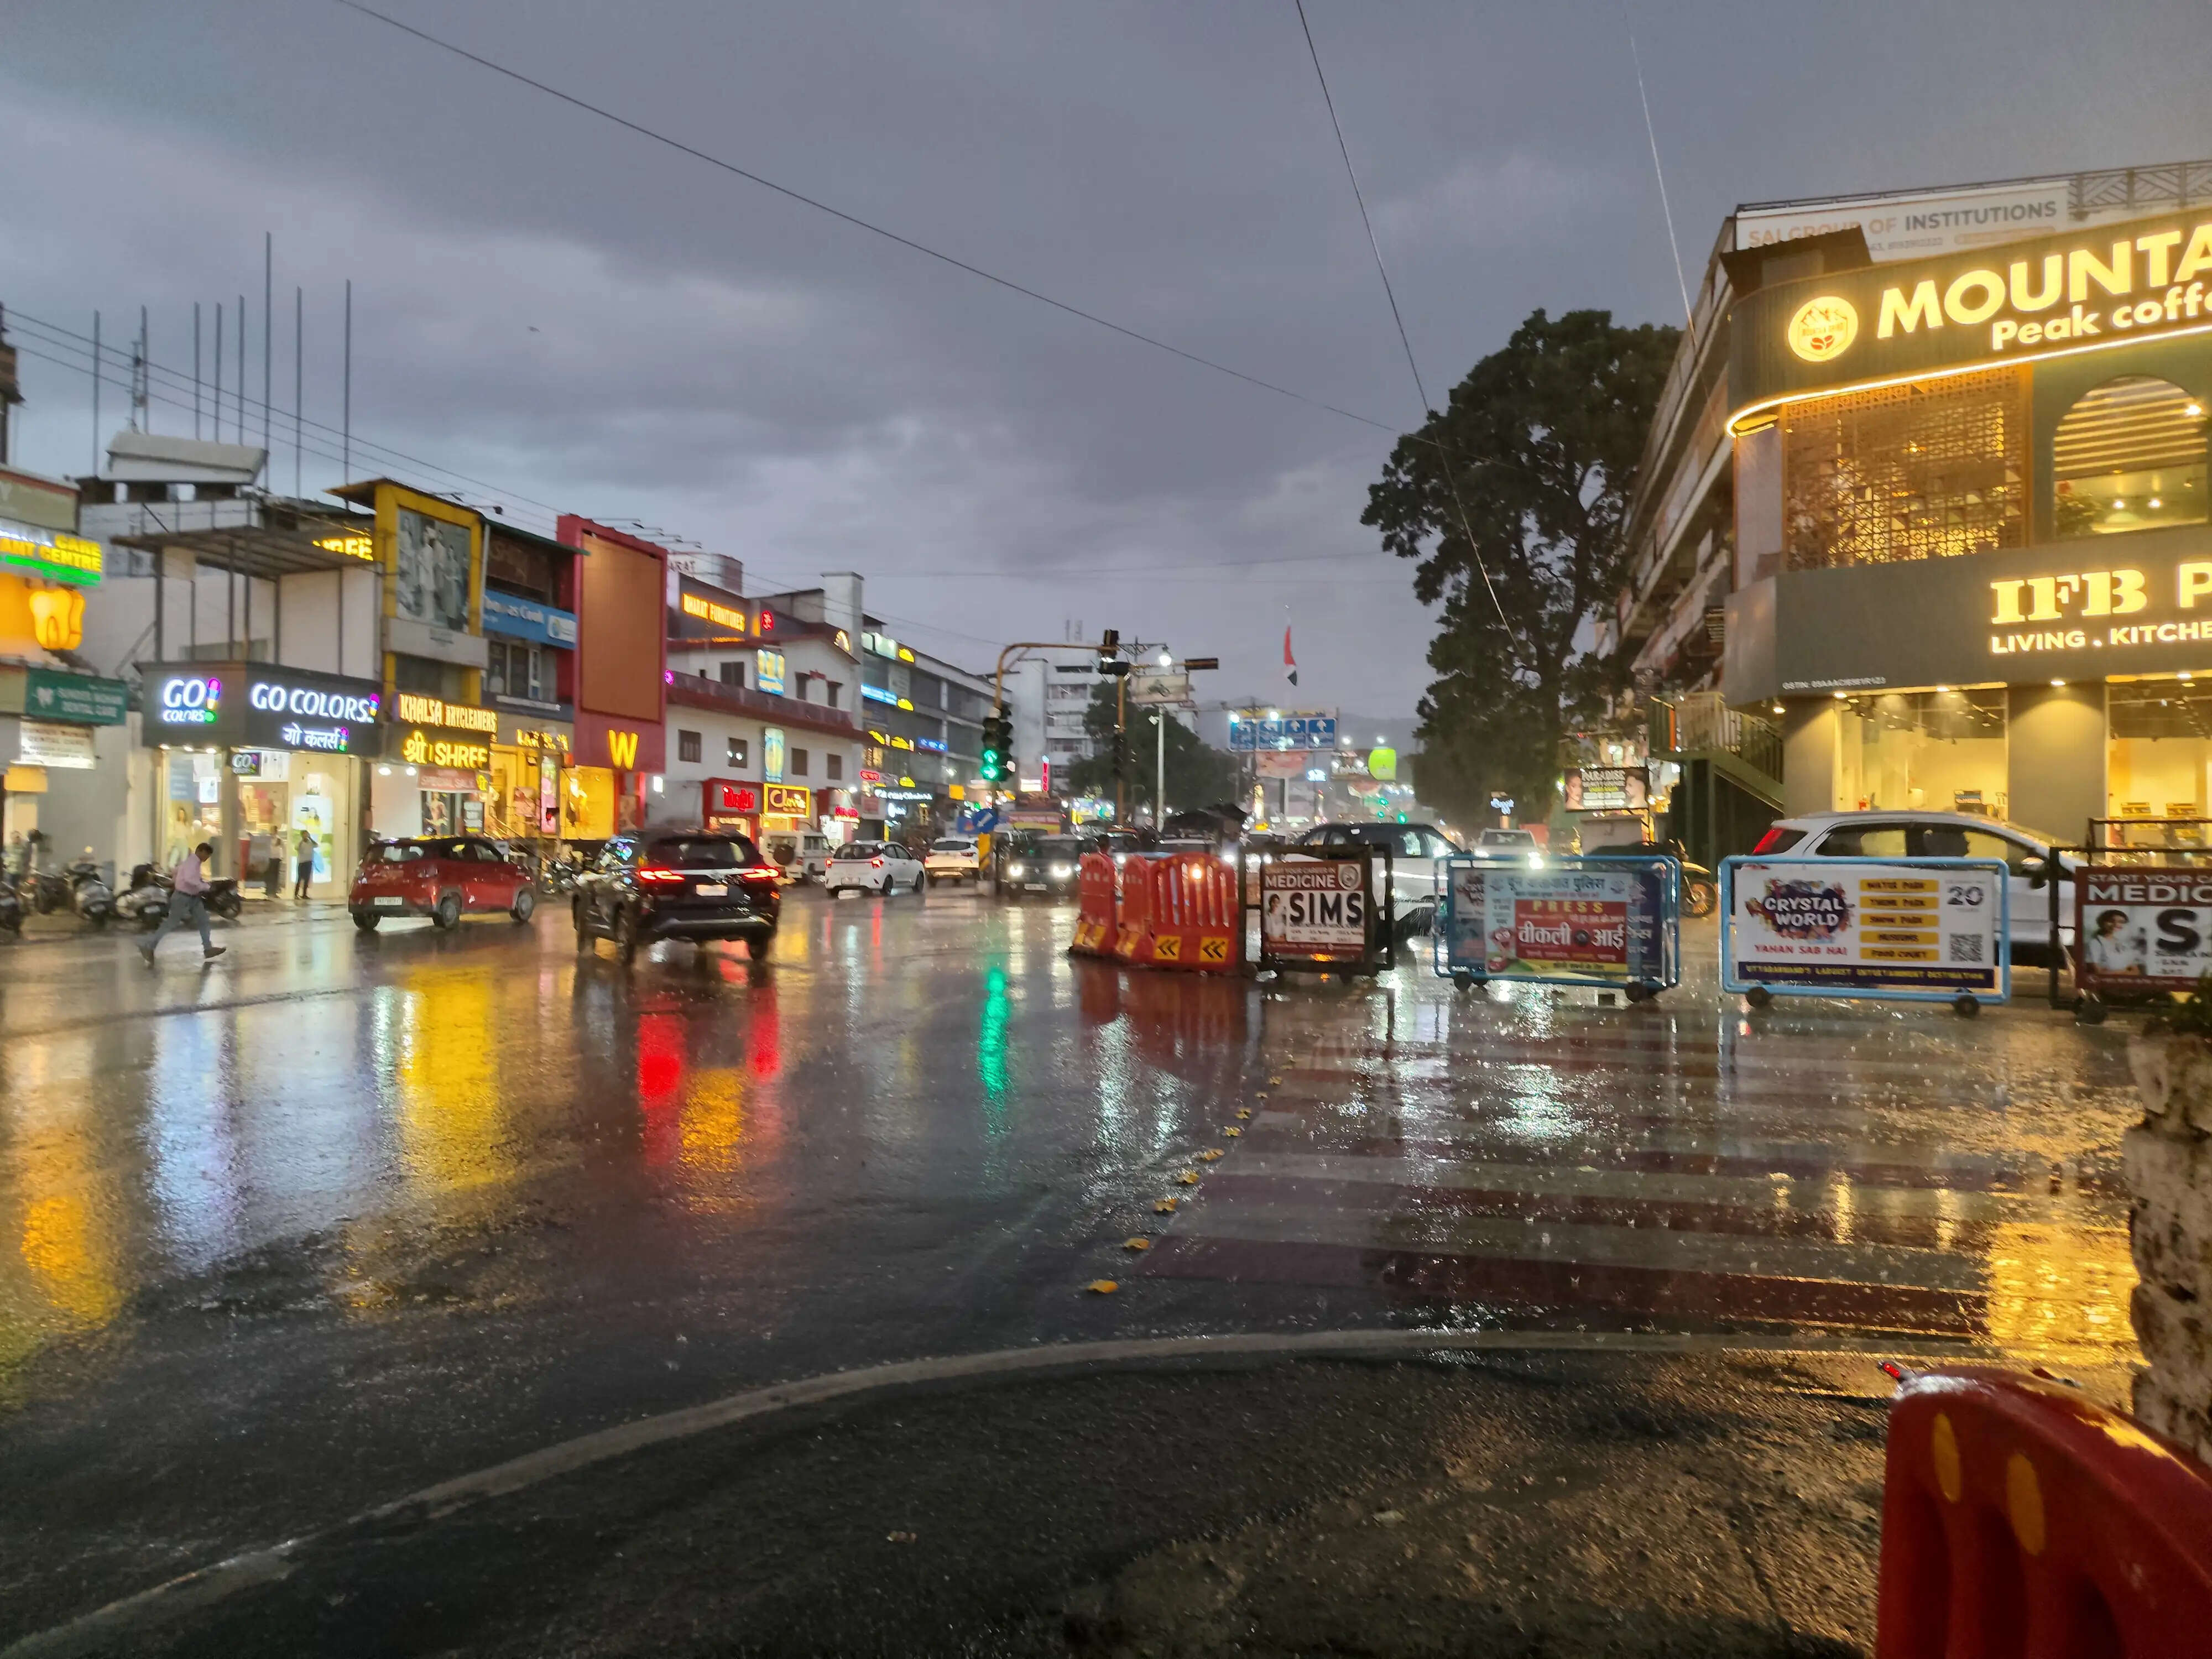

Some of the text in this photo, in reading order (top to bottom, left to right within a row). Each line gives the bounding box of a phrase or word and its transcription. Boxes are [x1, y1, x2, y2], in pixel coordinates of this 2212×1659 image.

[1788, 221, 1861, 239] GRO
[1869, 218, 1897, 235] OF
[1906, 201, 2057, 232] INSTITUTIONS
[1992, 282, 2212, 345] Peak coff
[39, 545, 102, 572] CENTRE
[55, 535, 102, 557] CARE
[1990, 569, 2148, 624] IFB
[1991, 630, 2086, 654] LIVING
[252, 684, 286, 712] GO
[399, 694, 442, 727] KHALSA
[163, 710, 206, 722] COLORS
[283, 722, 302, 744] गो
[403, 730, 427, 764] श्री
[608, 729, 638, 770] W
[1265, 874, 1336, 888] MEDICINE
[2088, 874, 2140, 883] START
[2144, 874, 2193, 884] YOUR
[1764, 896, 1844, 911] CRYSTAL
[1947, 886, 1984, 906] 20
[2088, 885, 2212, 902] MEDIC
[1289, 892, 1363, 926] SIMS
[1533, 900, 1604, 913] PRESS
[1775, 912, 1839, 926] WORLD
[1517, 920, 1571, 946] वीकली
[2156, 909, 2201, 952] S
